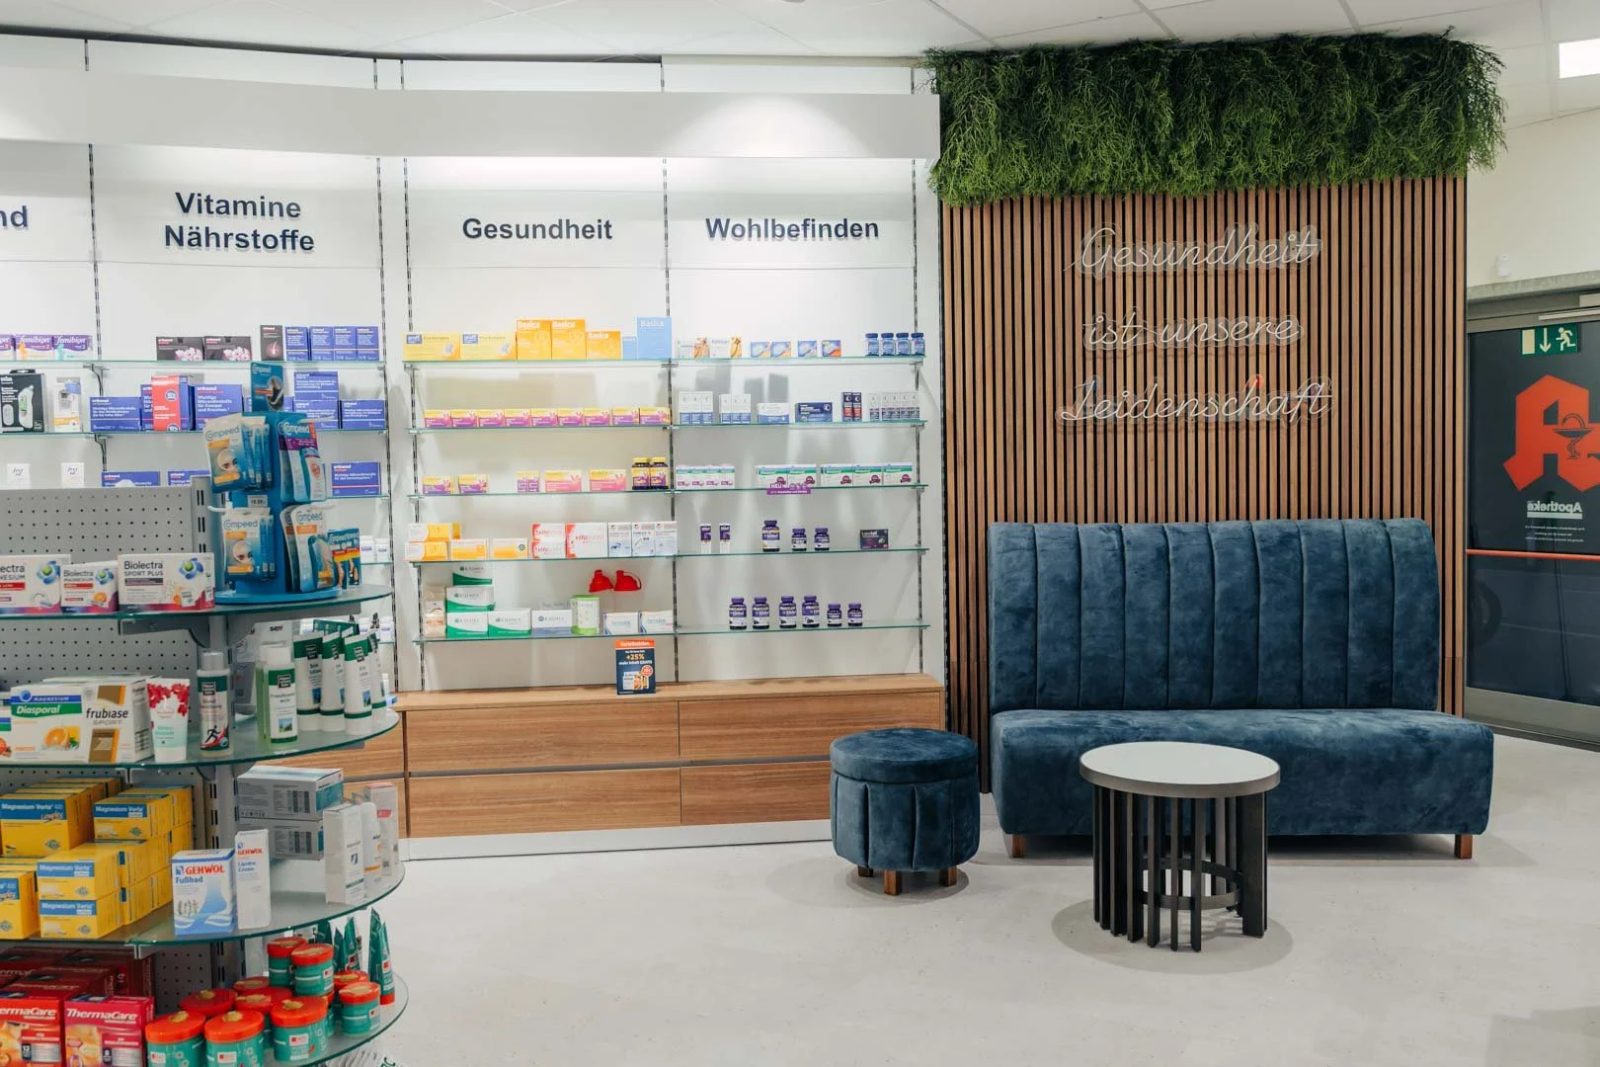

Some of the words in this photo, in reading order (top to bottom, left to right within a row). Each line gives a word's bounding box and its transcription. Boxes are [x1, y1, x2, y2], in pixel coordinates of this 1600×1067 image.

[175, 191, 302, 217] Vitamine
[462, 217, 613, 239] Gesundheit
[706, 217, 879, 240] Wohlbefinden
[165, 224, 315, 251] Nährstoffe
[1079, 225, 1318, 273] Gesundheit
[1088, 312, 1143, 345] ist
[1160, 318, 1300, 343] unsere
[1061, 378, 1333, 423] Leidenschaft
[296, 510, 323, 525] Compeed
[223, 519, 258, 531] Compeed
[124, 560, 163, 570] Biolectra
[64, 569, 94, 577] Biolectra
[16, 704, 61, 716] Diasporal
[86, 708, 129, 719] frubiase
[237, 848, 263, 856] GEHWOL
[186, 864, 225, 876] GEHWOL
[66, 1008, 138, 1021] ThermaCare
